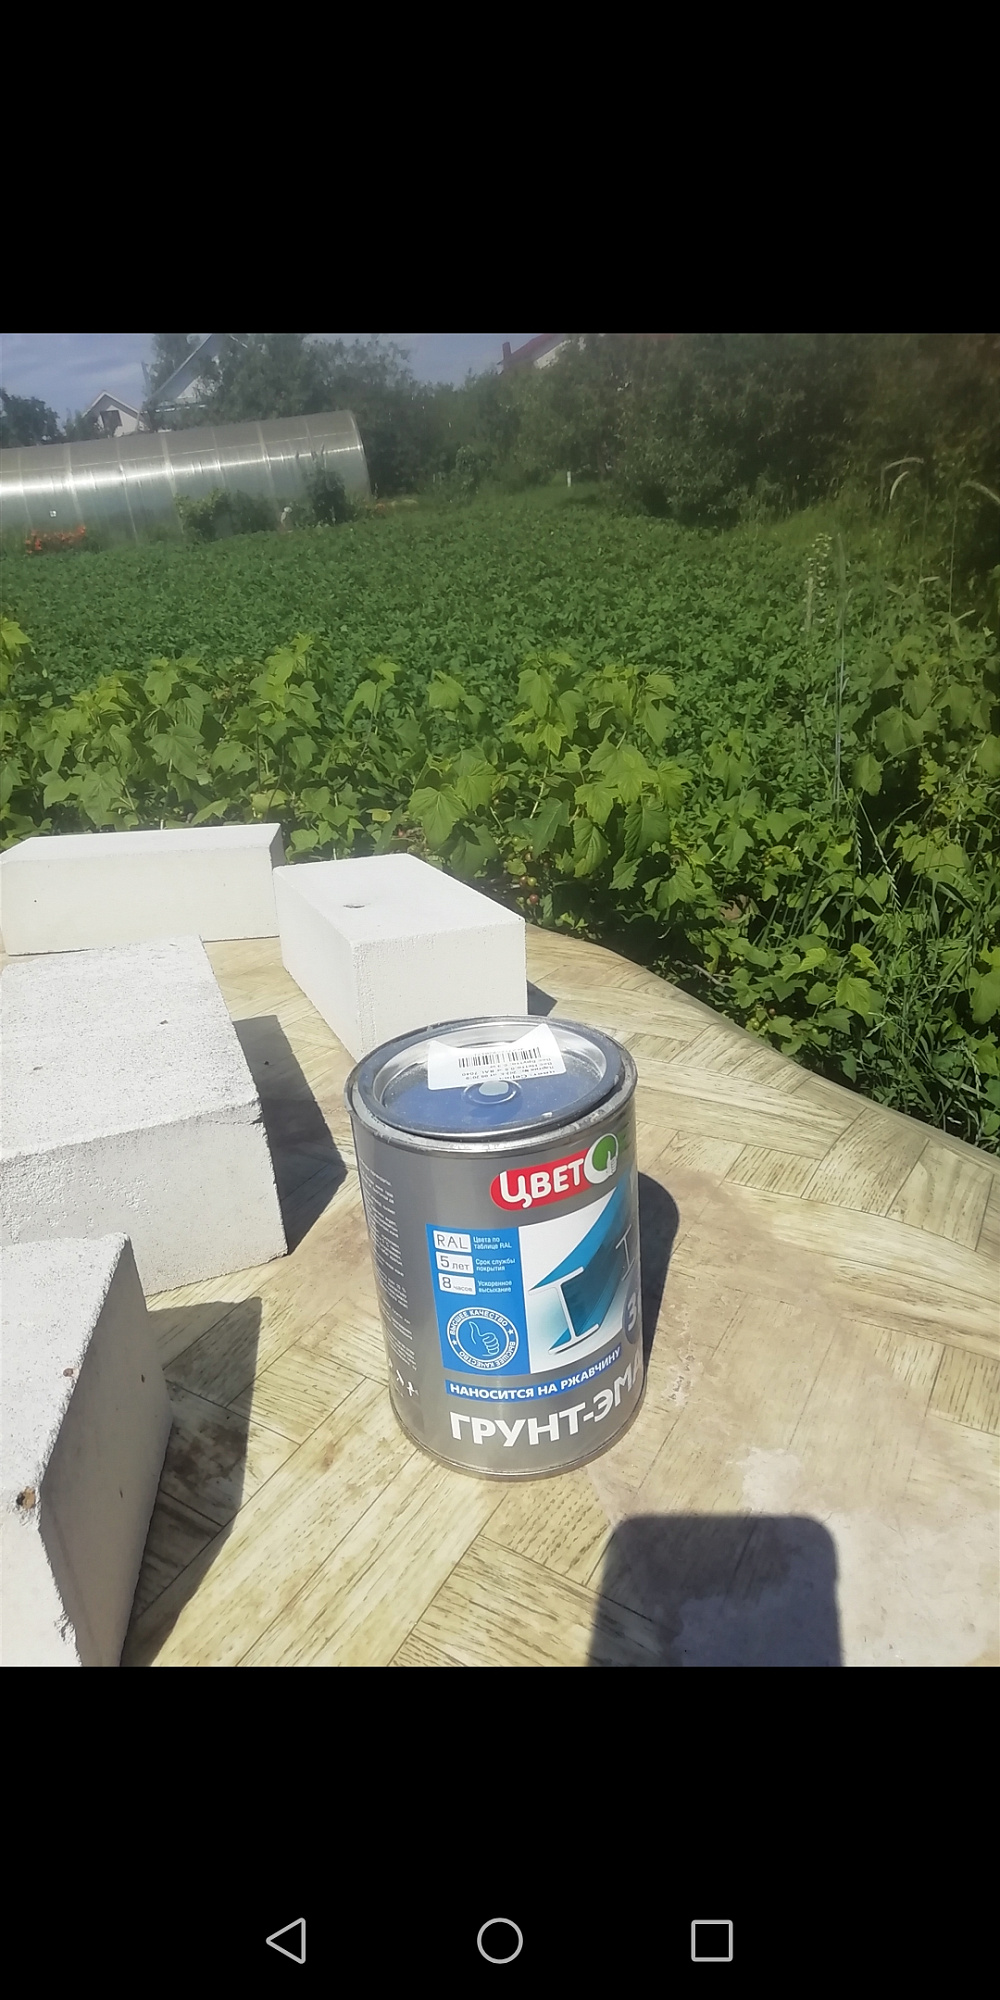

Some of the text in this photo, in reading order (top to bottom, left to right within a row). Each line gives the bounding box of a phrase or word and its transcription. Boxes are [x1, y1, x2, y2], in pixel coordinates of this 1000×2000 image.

[437, 1234, 468, 1250] RAL
[473, 1236, 491, 1244] Цвета
[474, 1243, 499, 1251] таблице
[440, 1255, 470, 1271] 5 лет
[475, 1257, 516, 1267] Срок службы
[442, 1276, 473, 1292] 8 часов
[477, 1280, 513, 1288] Ускоренное
[449, 1309, 508, 1335] ВЫСШЕЕ КАЧЕСТВО
[460, 1341, 516, 1369] ВЫСШЕЕ КАЧЕСТВО
[450, 1346, 621, 1399] НАНОСИТСЯ НА РЖАВЧИНУ
